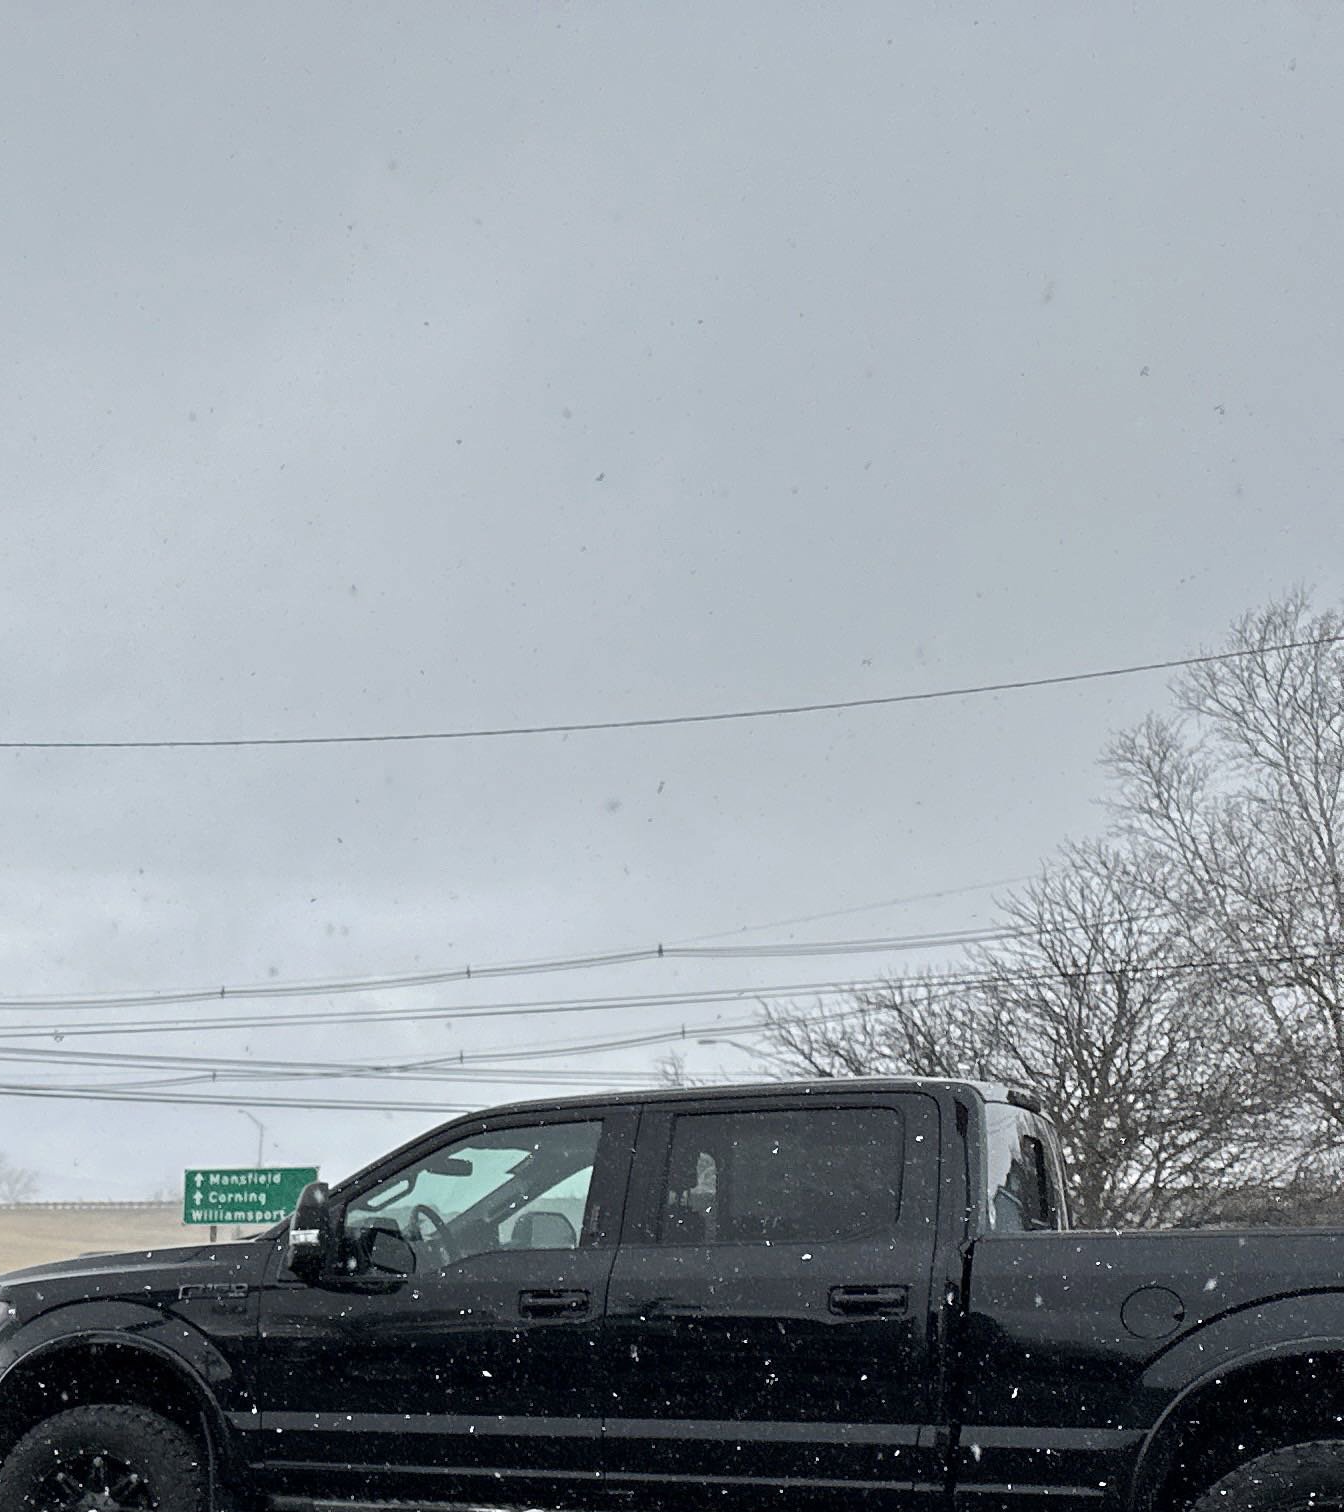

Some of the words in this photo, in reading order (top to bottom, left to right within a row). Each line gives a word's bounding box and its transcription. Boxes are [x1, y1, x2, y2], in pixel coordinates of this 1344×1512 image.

[209, 1173, 282, 1186] Mansfield
[208, 1191, 267, 1205] Corning
[191, 1208, 287, 1223] Williamsport
